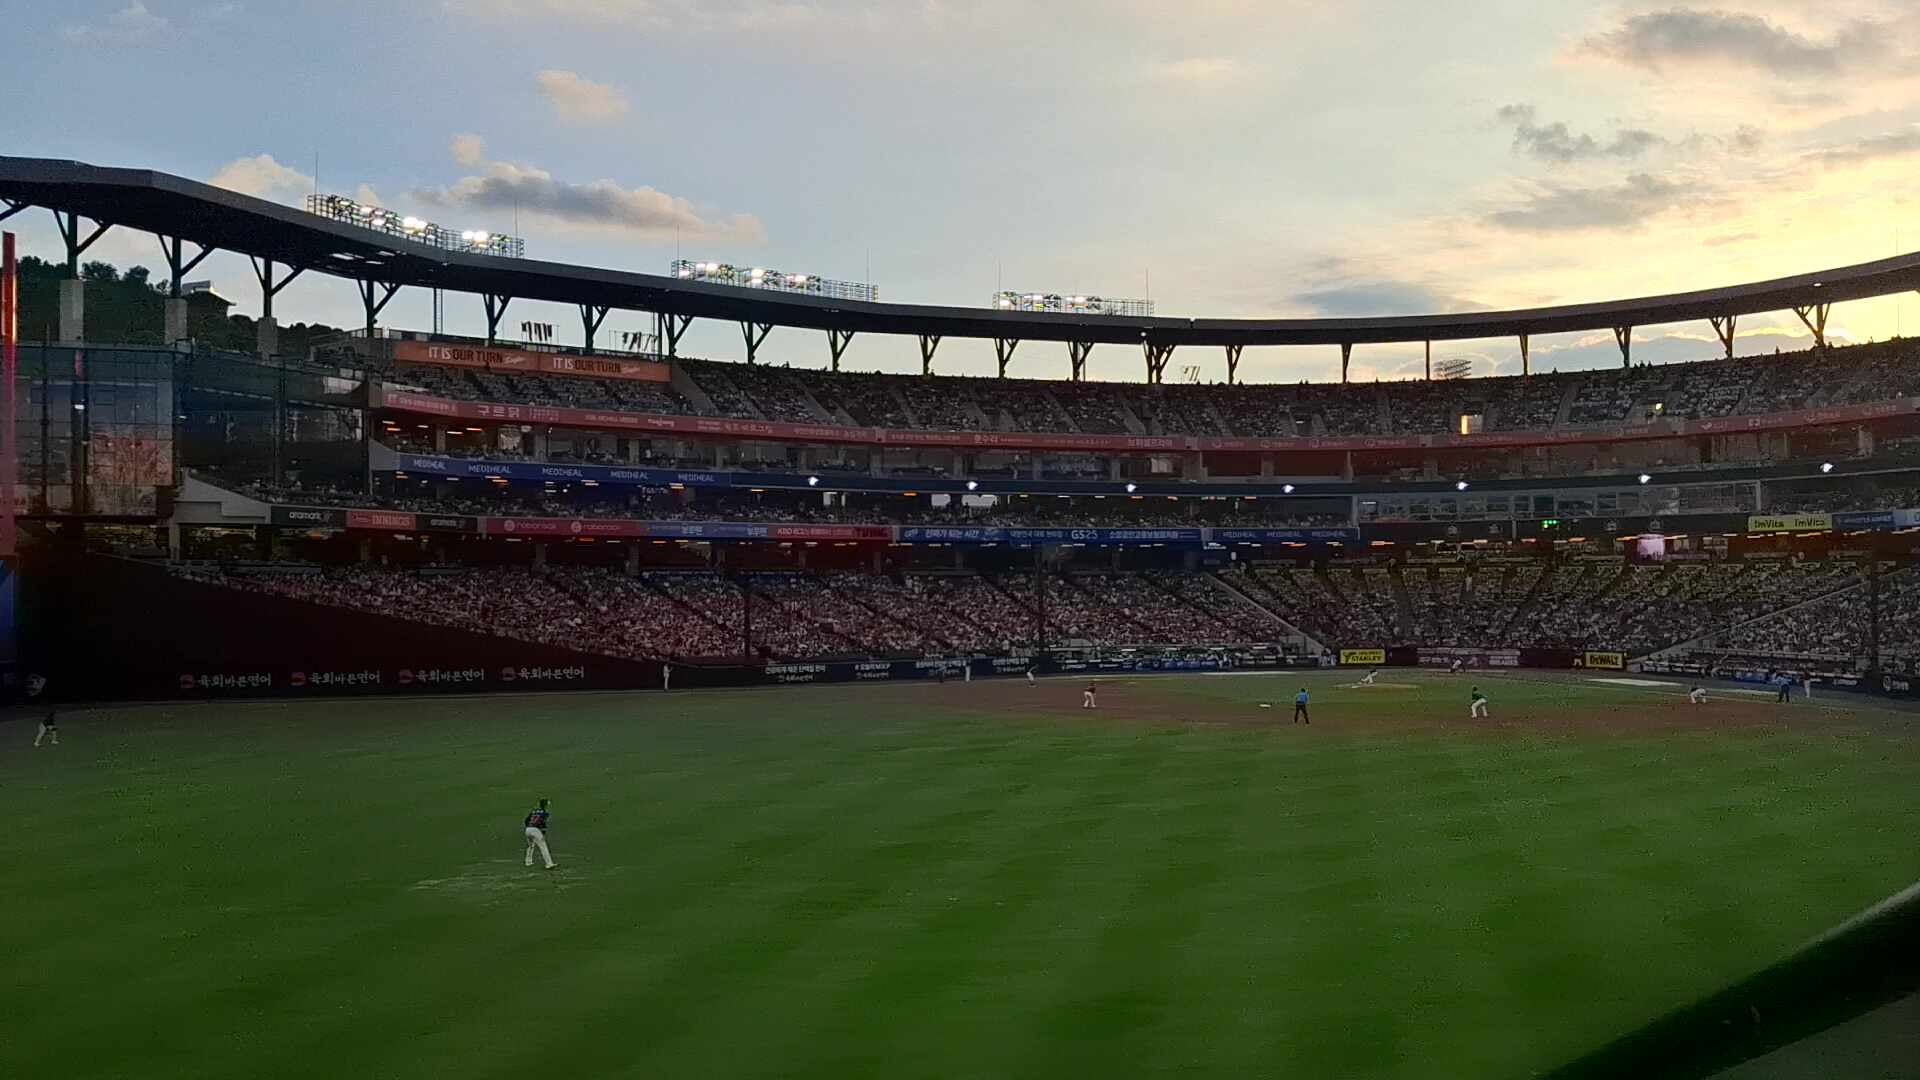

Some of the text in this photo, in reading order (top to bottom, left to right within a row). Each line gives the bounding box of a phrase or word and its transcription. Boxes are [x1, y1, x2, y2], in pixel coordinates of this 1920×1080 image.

[428, 346, 438, 360] IT
[441, 347, 452, 361] IS
[452, 348, 474, 362] OUR
[476, 350, 503, 364] TURN
[553, 357, 563, 369] IT
[564, 358, 574, 370] IS
[574, 359, 594, 372] OUR
[596, 360, 622, 374] TURN
[468, 464, 512, 475] MEDIHEAL
[542, 467, 583, 478] MEDIHEAL
[610, 470, 649, 481] MEDIHEAL
[677, 473, 715, 483] MEDIHEAL
[288, 511, 323, 520] aramark
[1071, 529, 1098, 540] GS25
[308, 670, 381, 685] 육회바른연어
[416, 668, 486, 683] 육회바른연어
[518, 665, 585, 681] 육회바른연어
[198, 672, 272, 688] 육회바른연어
